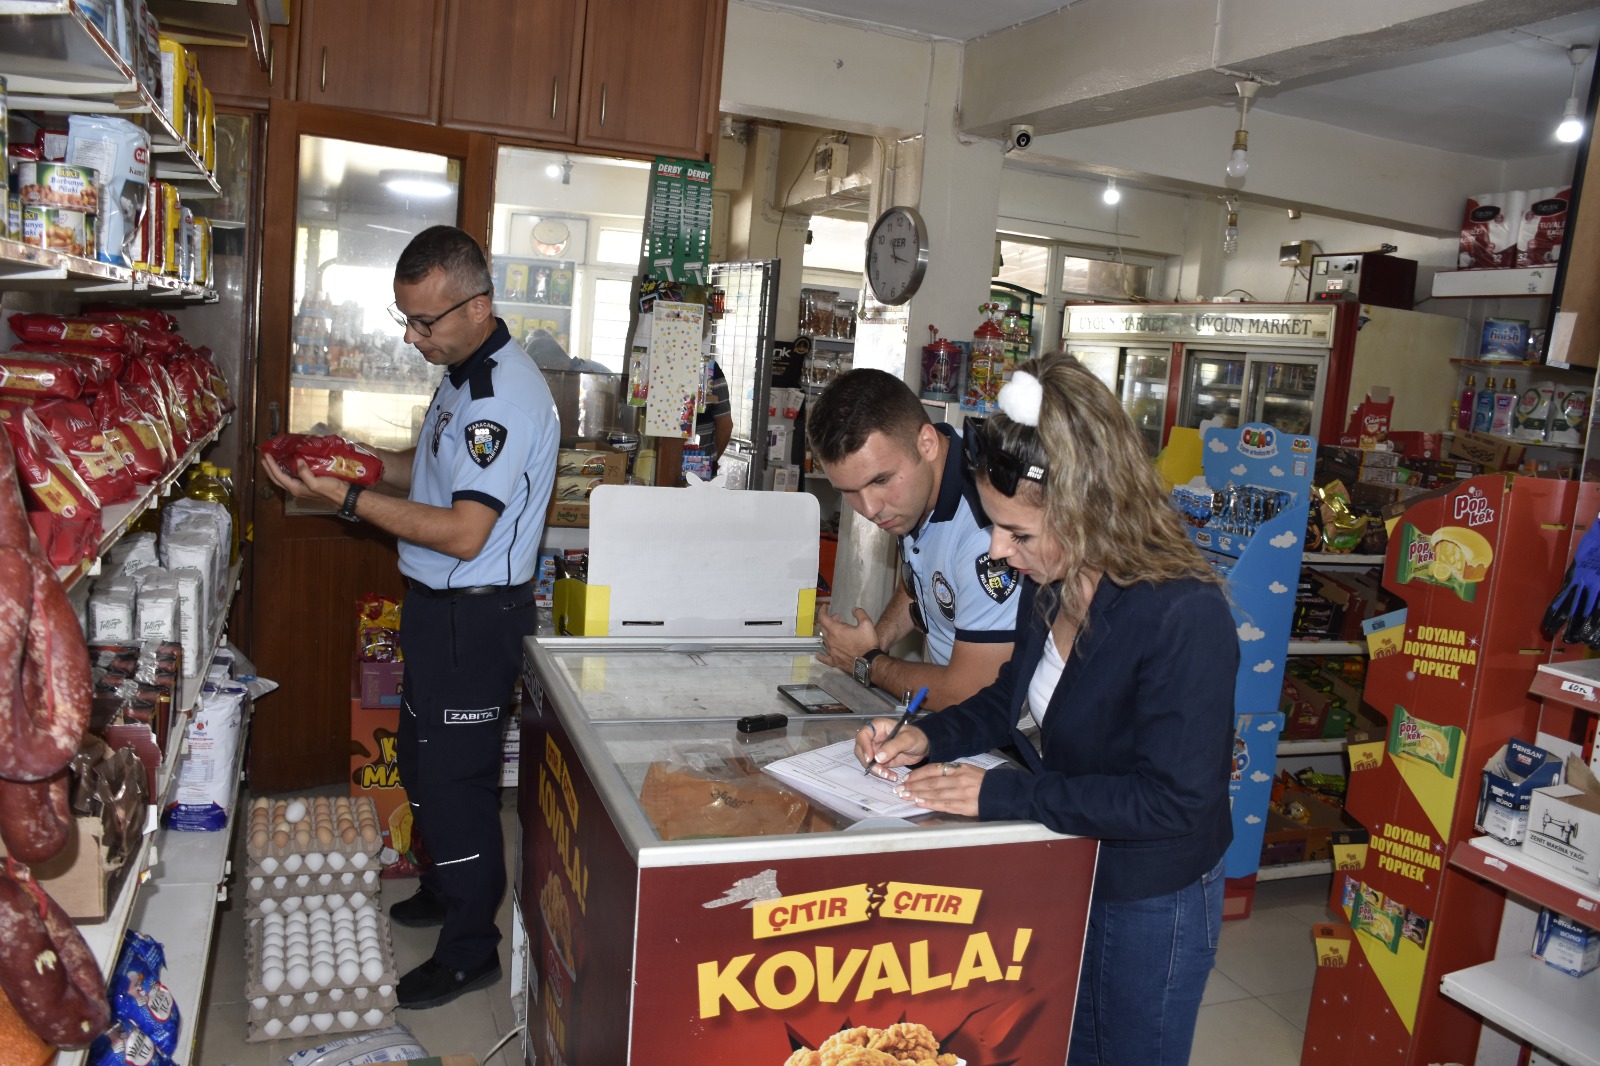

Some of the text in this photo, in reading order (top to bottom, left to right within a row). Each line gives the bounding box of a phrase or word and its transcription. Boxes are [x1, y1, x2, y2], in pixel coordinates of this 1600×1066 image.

[57, 169, 79, 178] BURCU
[658, 164, 682, 174] DERBY
[687, 168, 711, 179] DERBY
[51, 177, 84, 187] Barbunya
[58, 185, 78, 193] Pilaki
[24, 222, 44, 230] unya
[887, 223, 893, 232] 11
[897, 218, 903, 227] 12
[908, 223, 911, 231] 1
[878, 235, 885, 246] 10
[913, 235, 917, 244] 2
[873, 253, 877, 263] 9
[875, 271, 879, 280] 8
[881, 283, 886, 292] 7
[890, 288, 895, 297] 6
[901, 283, 905, 292] 5
[1120, 316, 1168, 331] MARKET
[1195, 317, 1312, 336] UYGUN MARKET
[1490, 328, 1519, 342] finish
[773, 347, 791, 357] nk
[467, 422, 500, 432] KARACABEY
[1243, 430, 1274, 448] OZMO
[608, 466, 620, 477] 75
[557, 512, 578, 522] halley
[1469, 509, 1494, 526] kek
[1418, 550, 1435, 564] kek
[980, 574, 998, 598] BELEDİYE
[1417, 625, 1465, 646] DOYANA
[1404, 641, 1476, 665] DOYMAYANA
[1413, 659, 1460, 680] POPKEK
[451, 711, 494, 721] ZABITA
[1407, 730, 1421, 741] kek
[1512, 743, 1544, 759] PENSAN
[361, 764, 400, 788] MA
[1496, 797, 1513, 808] BÜRO
[539, 762, 589, 917] KOVALA!
[1383, 823, 1430, 850] DOYANA
[1370, 835, 1441, 870] DOYMAYANA
[1530, 834, 1584, 861] ZENİT MAKİNA YAĞI
[1378, 854, 1426, 882] POPKEK
[768, 890, 963, 932] ÇITIR ÇITIR
[1553, 918, 1583, 933] PENSAN
[697, 928, 1033, 1019] KOVALA!
[160, 997, 170, 1013] TUZ
[138, 1044, 152, 1059] TUZ
